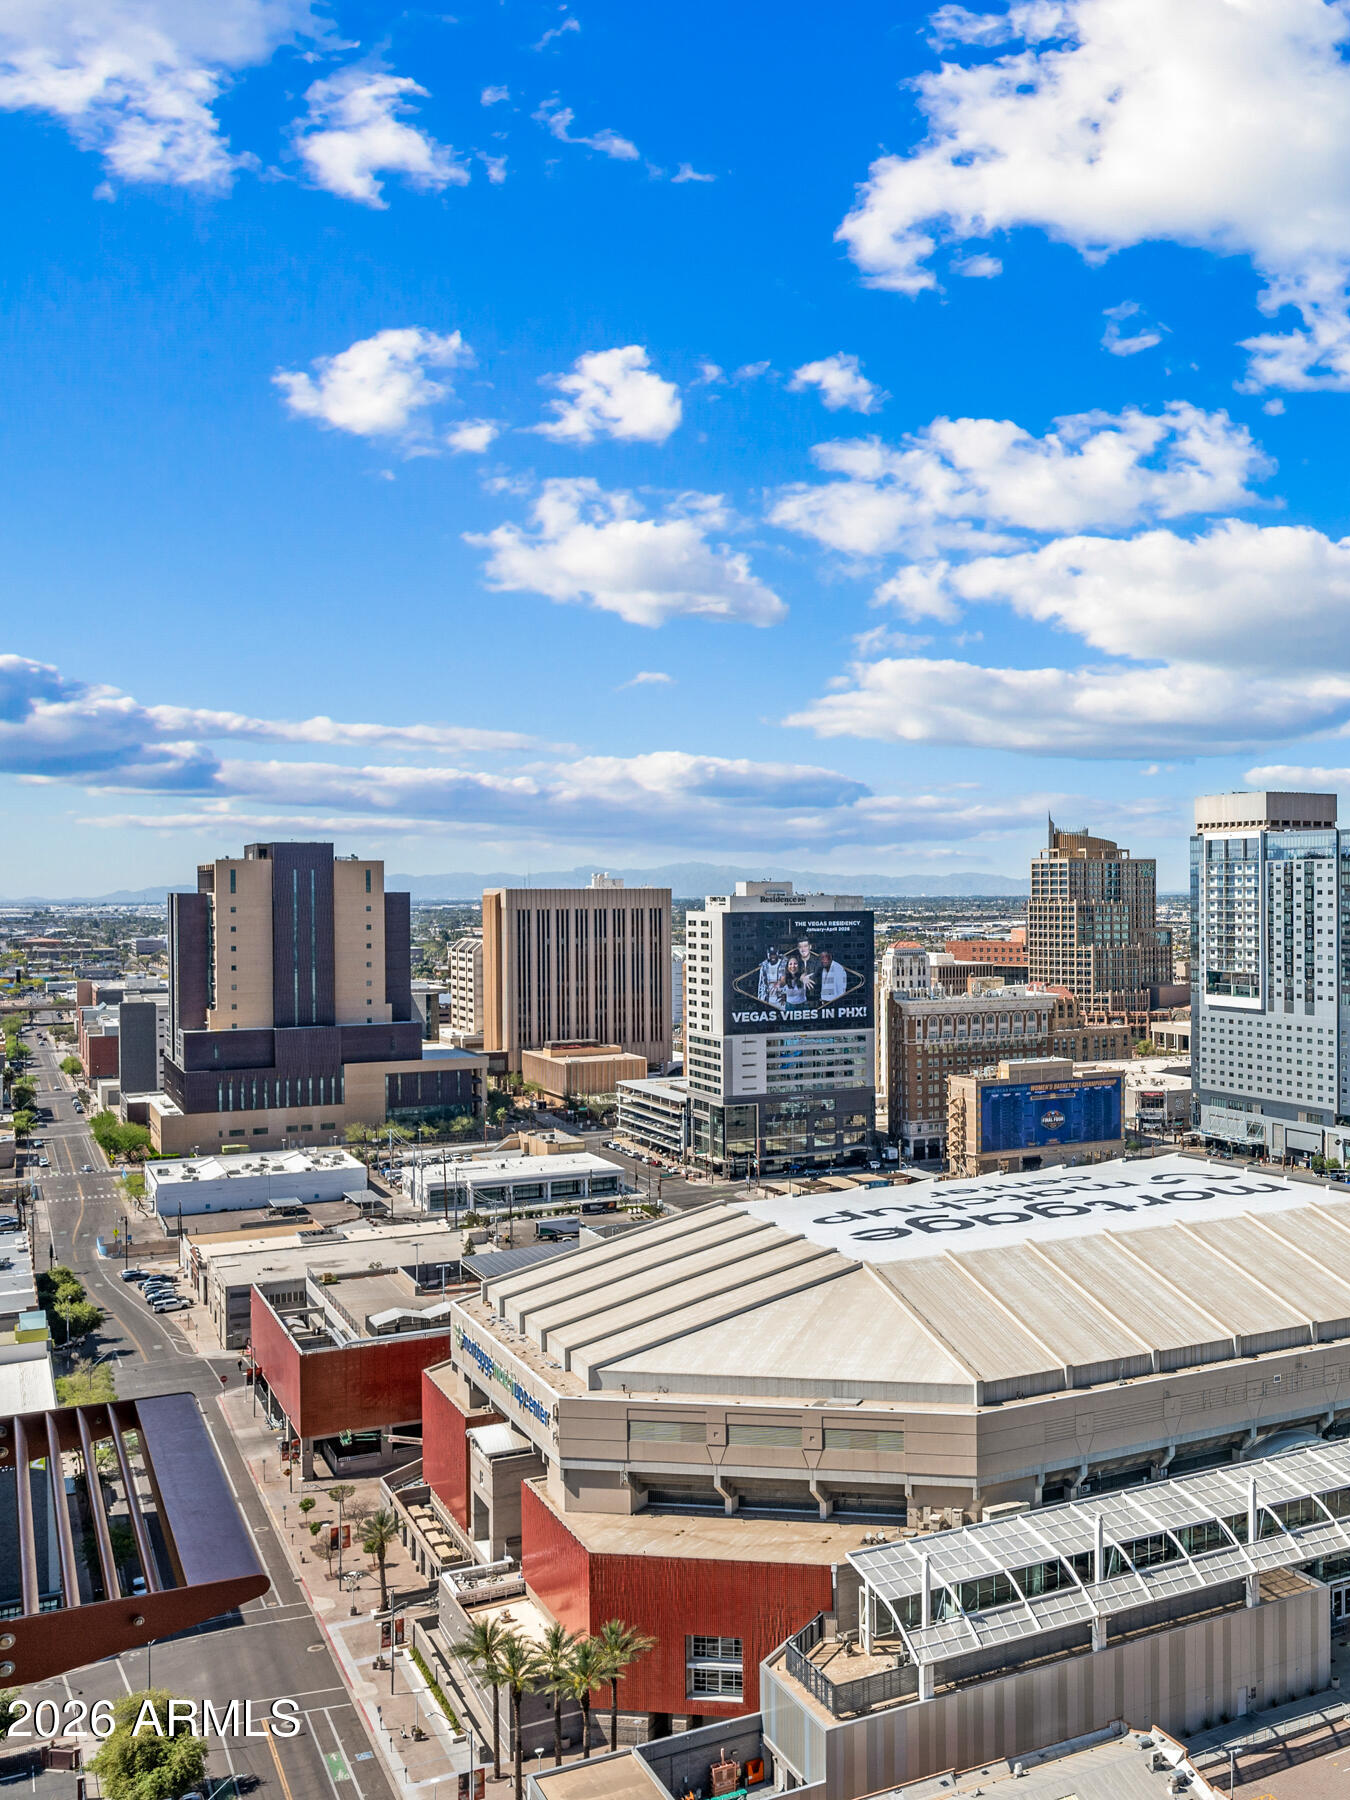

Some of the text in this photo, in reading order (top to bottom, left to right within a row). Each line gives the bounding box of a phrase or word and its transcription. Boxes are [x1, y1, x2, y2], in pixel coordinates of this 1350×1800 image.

[732, 1006, 867, 1023] VEGAS VIBES IN PHX!
[1053, 1081, 1081, 1090] BASKETBALL
[930, 1175, 1092, 1198] center
[812, 1181, 1141, 1225] matchup
[849, 1182, 1291, 1241] mortgage
